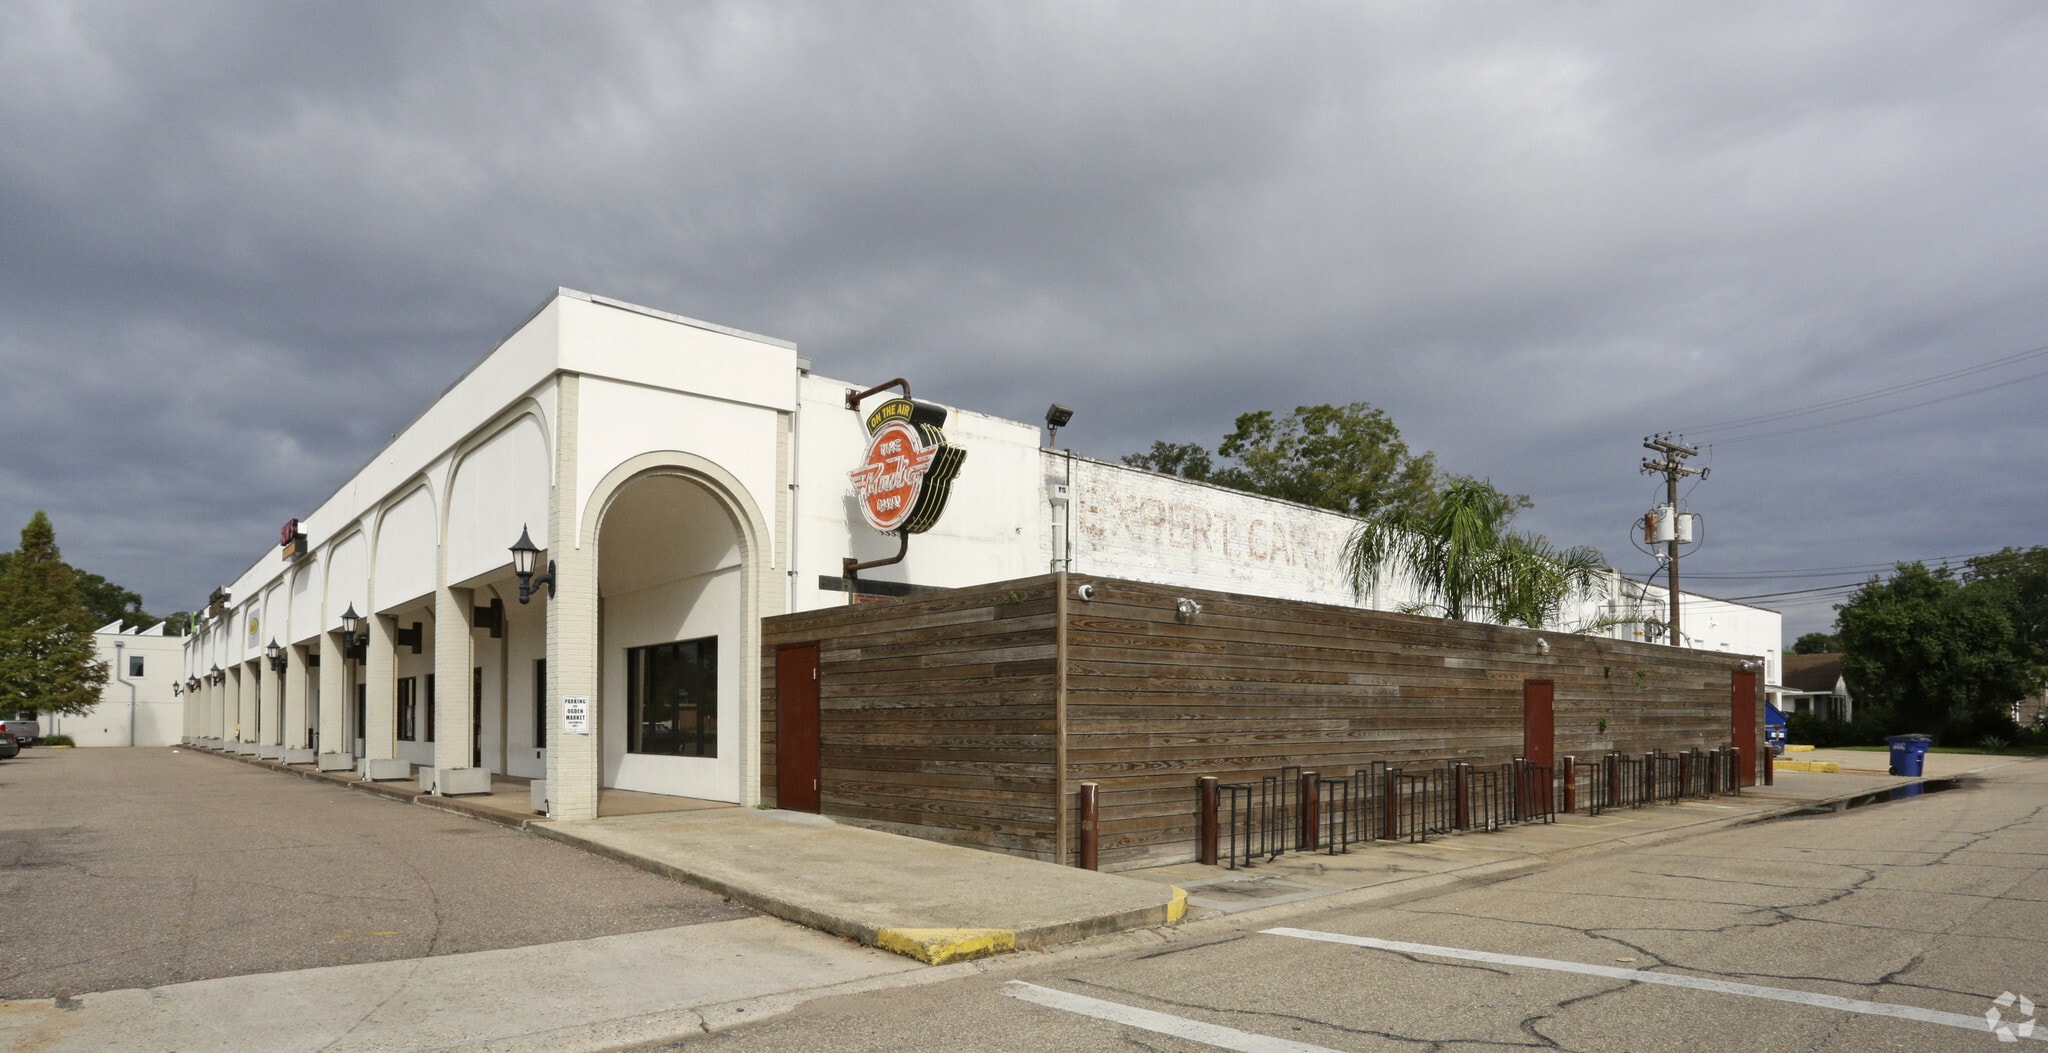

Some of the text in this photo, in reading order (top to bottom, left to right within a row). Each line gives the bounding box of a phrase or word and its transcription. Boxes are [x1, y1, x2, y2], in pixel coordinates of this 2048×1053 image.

[871, 404, 910, 428] ON THE AIR
